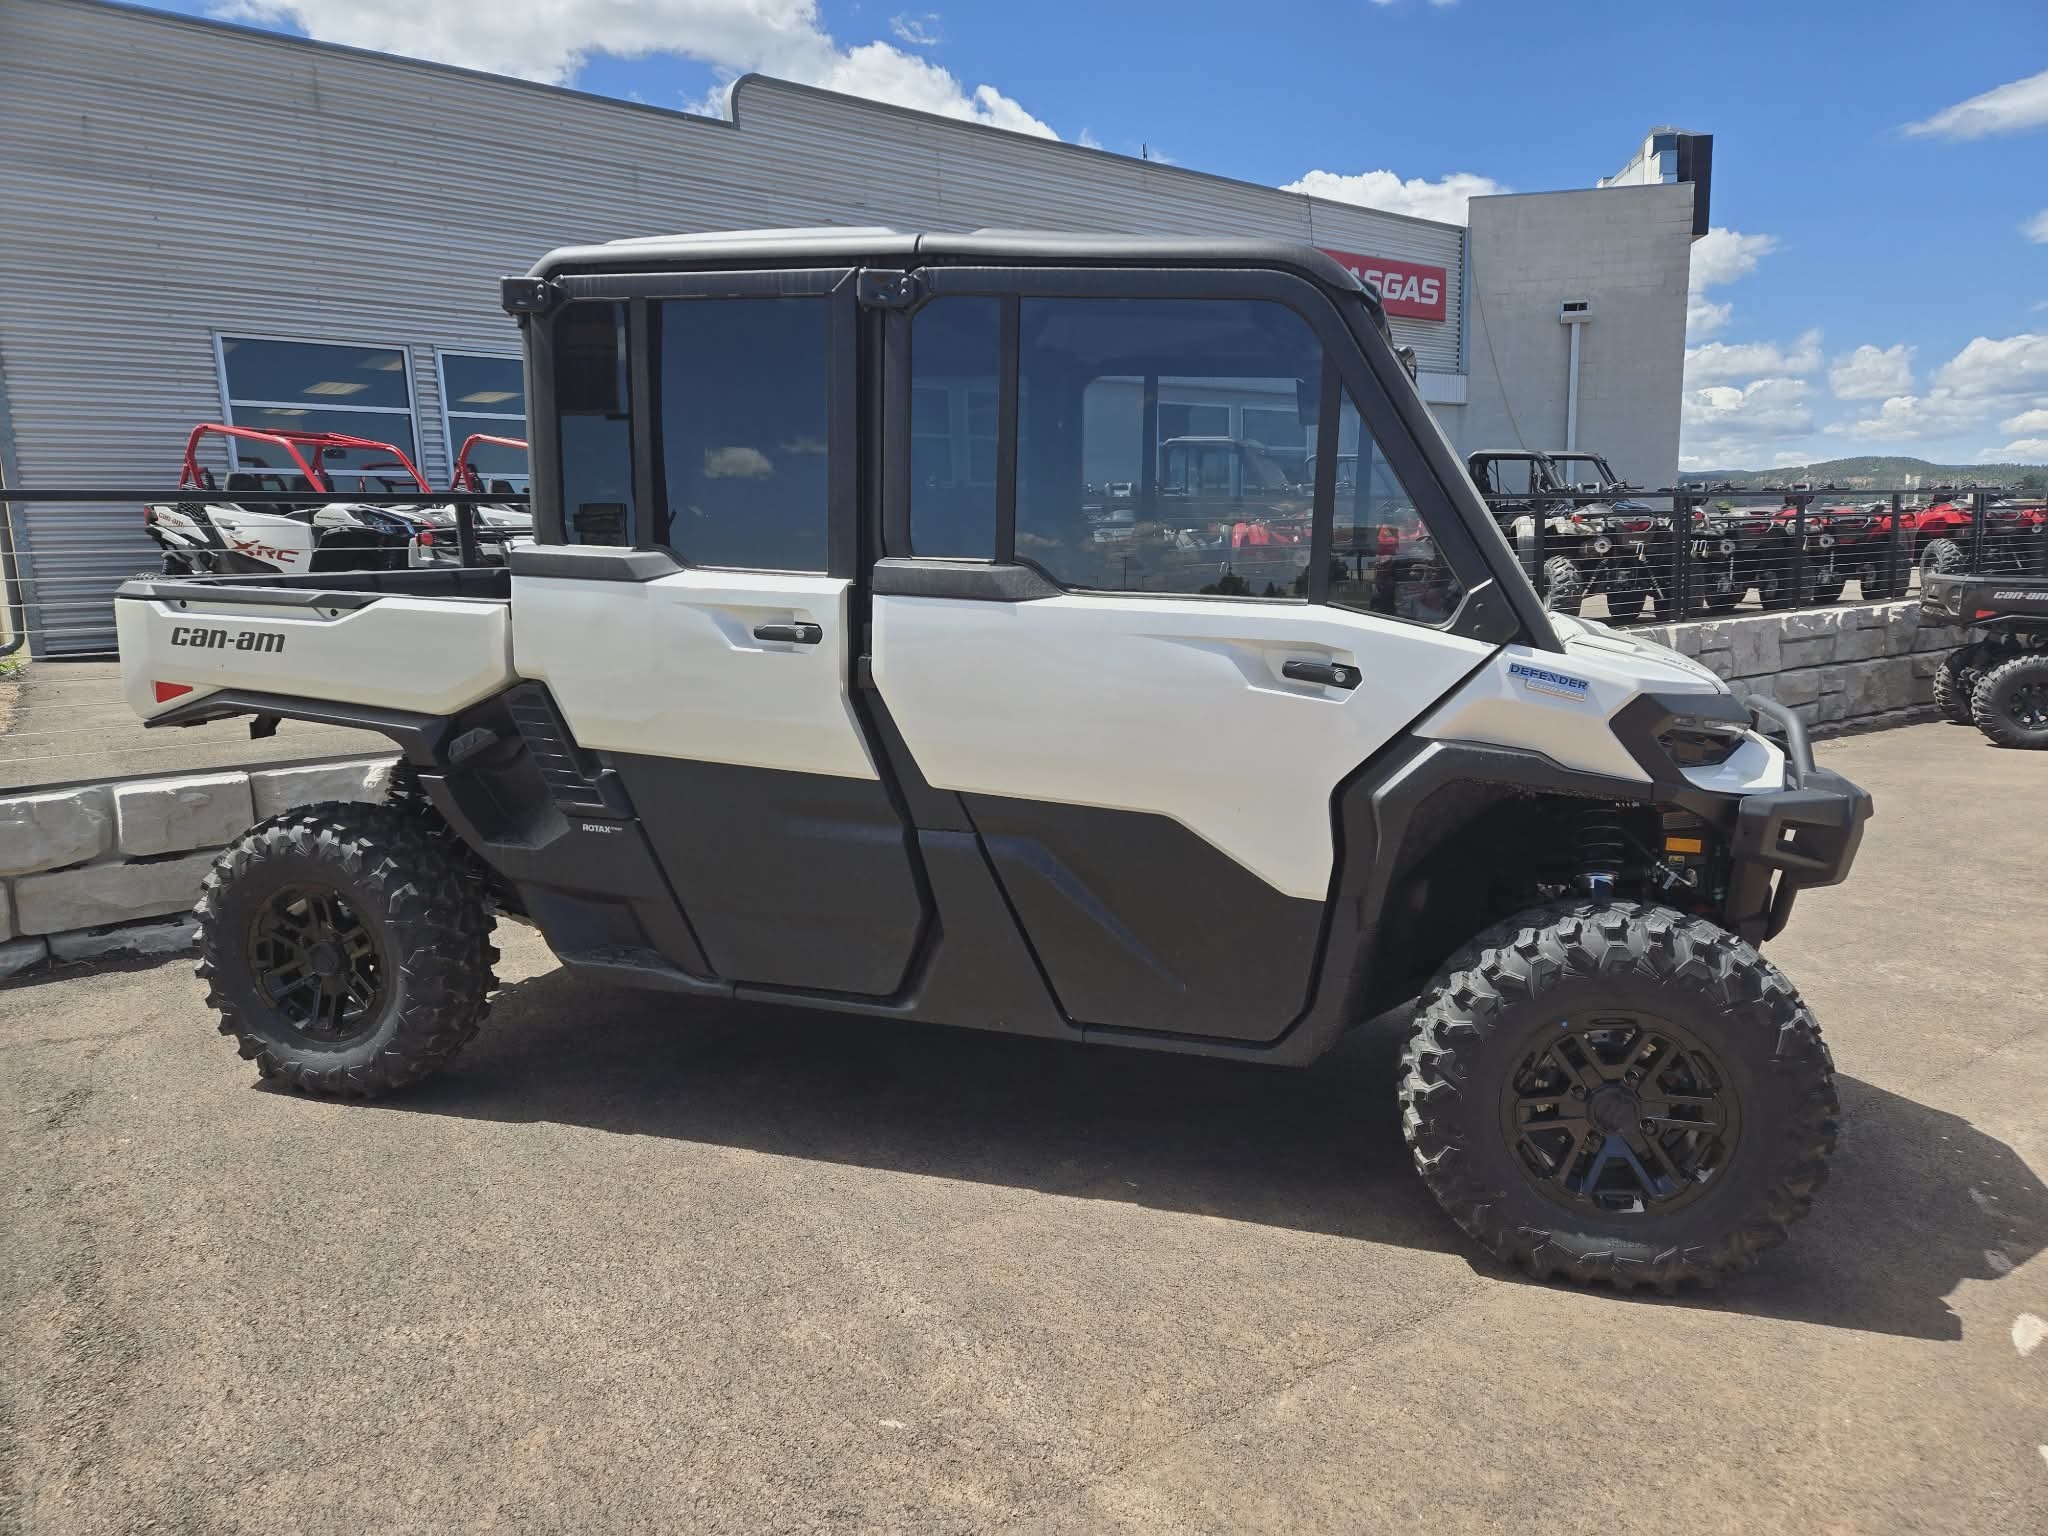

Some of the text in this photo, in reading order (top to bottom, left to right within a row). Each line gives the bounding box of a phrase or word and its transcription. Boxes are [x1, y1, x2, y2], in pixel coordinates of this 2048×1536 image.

[1349, 266, 1440, 305] SGAS
[171, 626, 286, 653] can-am
[1510, 663, 1588, 690] DEFENDER
[582, 823, 611, 833] ROTAX
